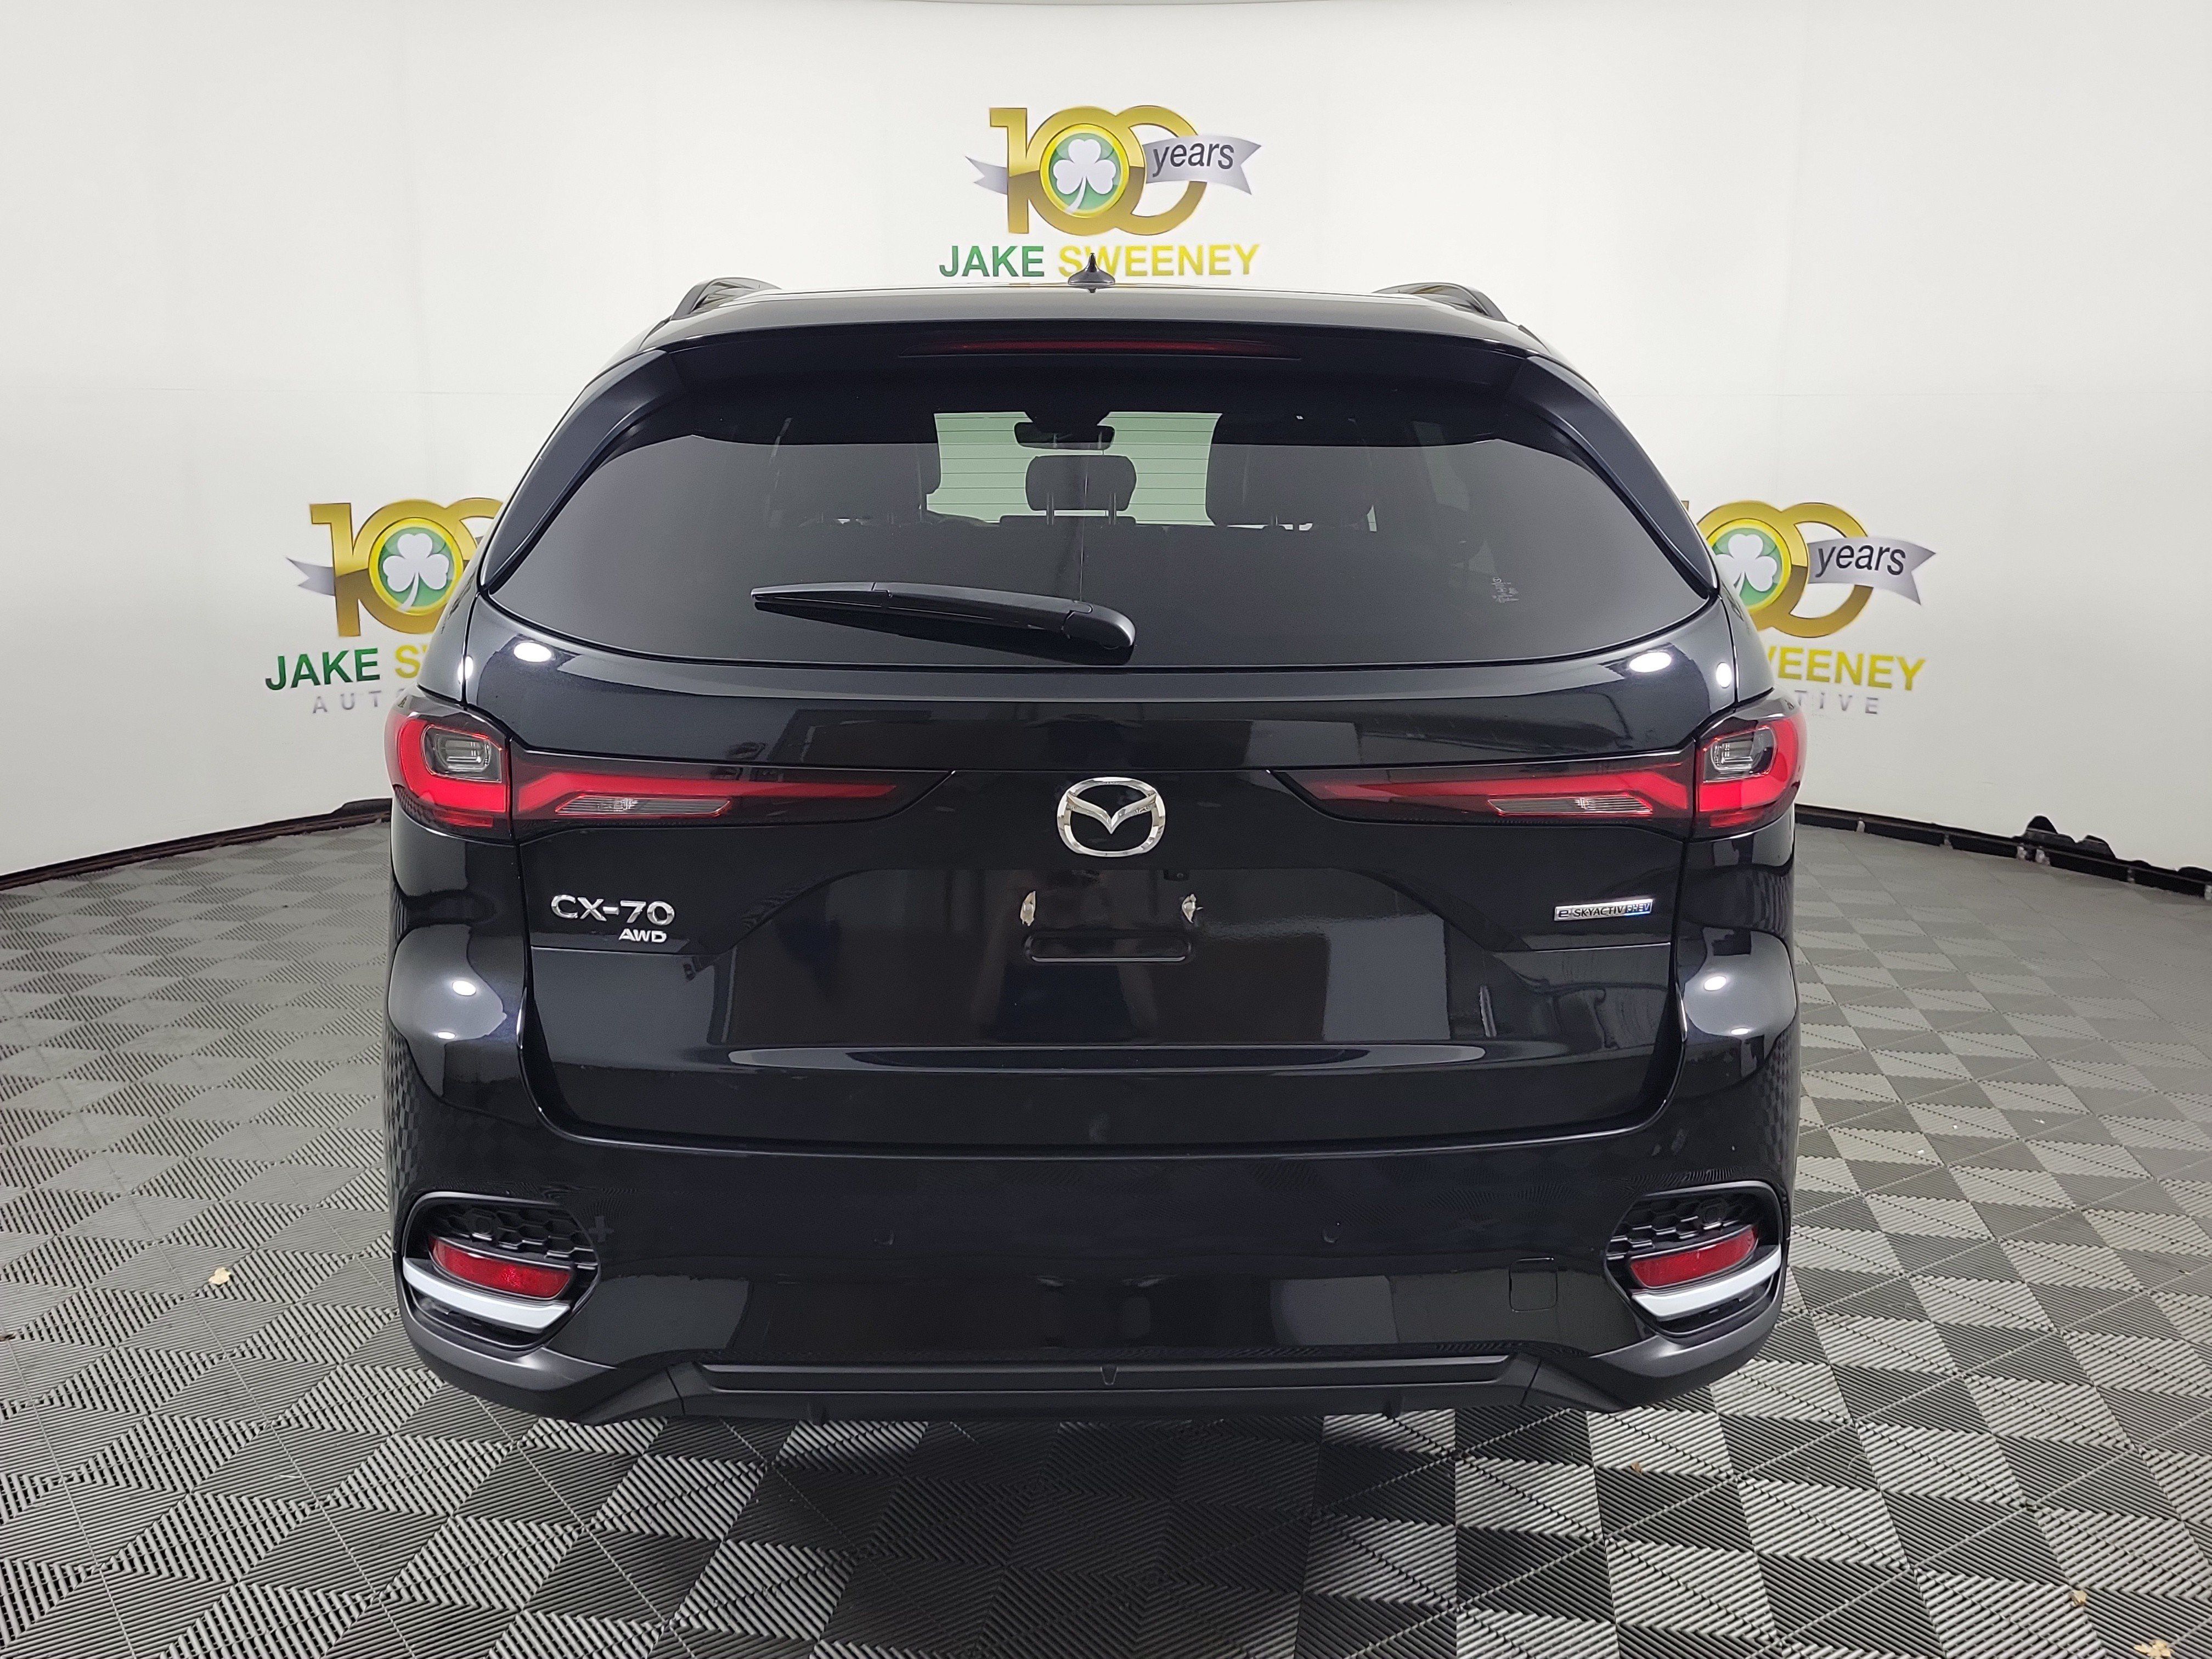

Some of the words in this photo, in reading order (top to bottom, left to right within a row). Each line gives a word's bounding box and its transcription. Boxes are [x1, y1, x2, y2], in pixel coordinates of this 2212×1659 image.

[990, 105, 1207, 236] 100
[1153, 143, 1235, 177] years
[939, 245, 1045, 277] JAKE
[1681, 500, 1872, 637] 00
[1815, 545, 1905, 578] years
[265, 647, 380, 690] JAKE
[1768, 646, 1926, 691] EENEY
[551, 894, 675, 926] CX-70
[618, 928, 667, 943] AWD
